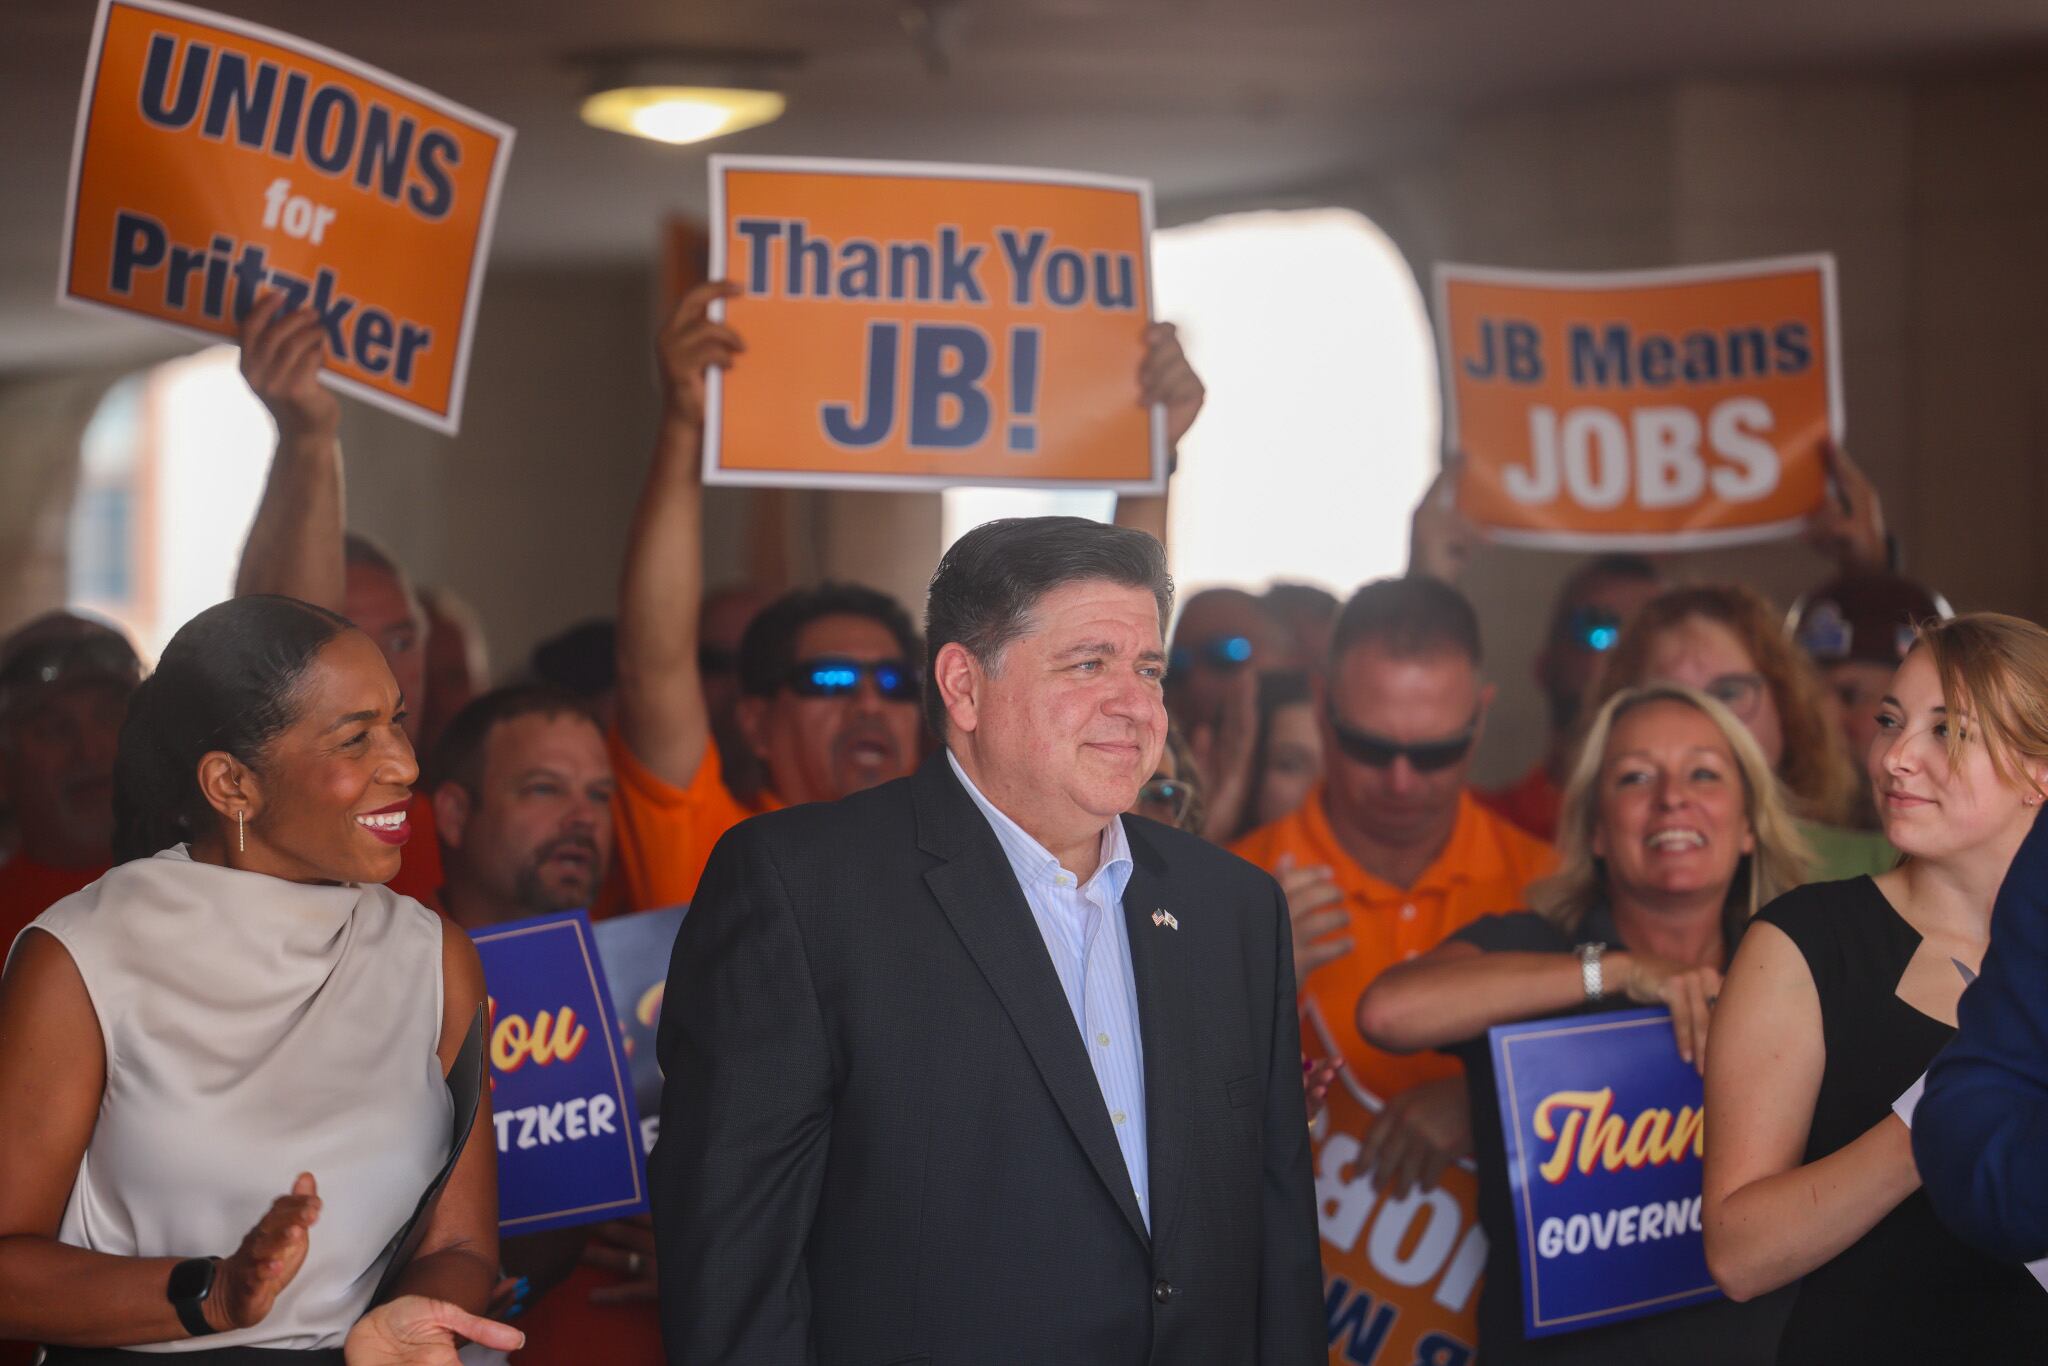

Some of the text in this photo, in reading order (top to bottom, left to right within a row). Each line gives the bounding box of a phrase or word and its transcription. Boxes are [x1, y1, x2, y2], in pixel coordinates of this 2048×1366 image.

[139, 32, 461, 220] UNIONS
[262, 178, 336, 245] for
[736, 217, 1137, 311] Thank You
[820, 321, 1042, 453] JB!
[1464, 318, 1813, 389] JB Means
[1503, 397, 1781, 511] JOBS
[488, 996, 589, 1078] ou
[493, 1093, 616, 1153] TZKER
[1533, 1086, 1704, 1185] Than
